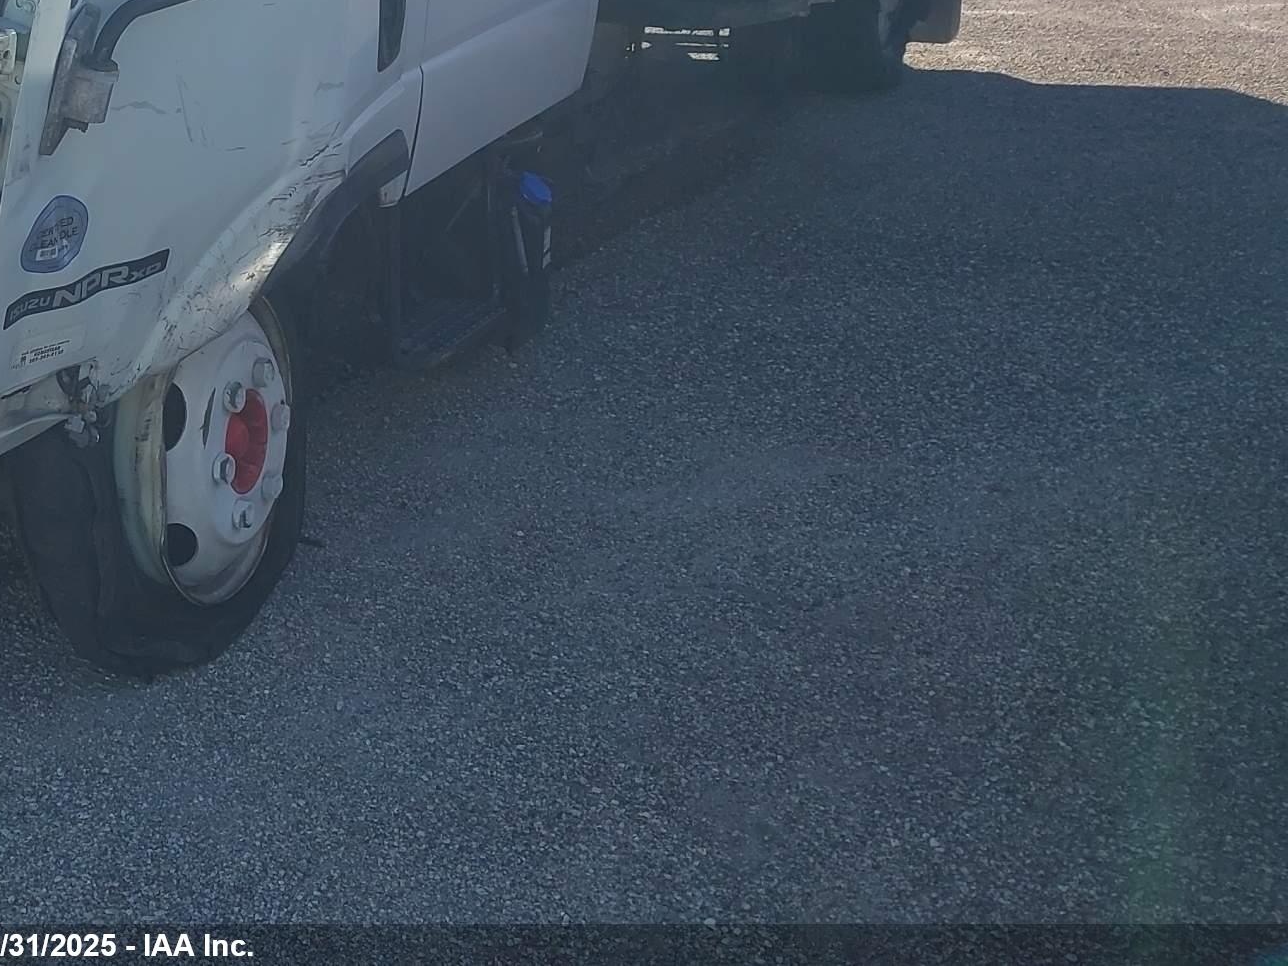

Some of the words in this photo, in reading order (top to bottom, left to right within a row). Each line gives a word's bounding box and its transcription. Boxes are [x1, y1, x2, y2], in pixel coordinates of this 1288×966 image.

[8, 296, 51, 322] ISUZU
[52, 265, 129, 307] NPR
[128, 261, 162, 281] XD
